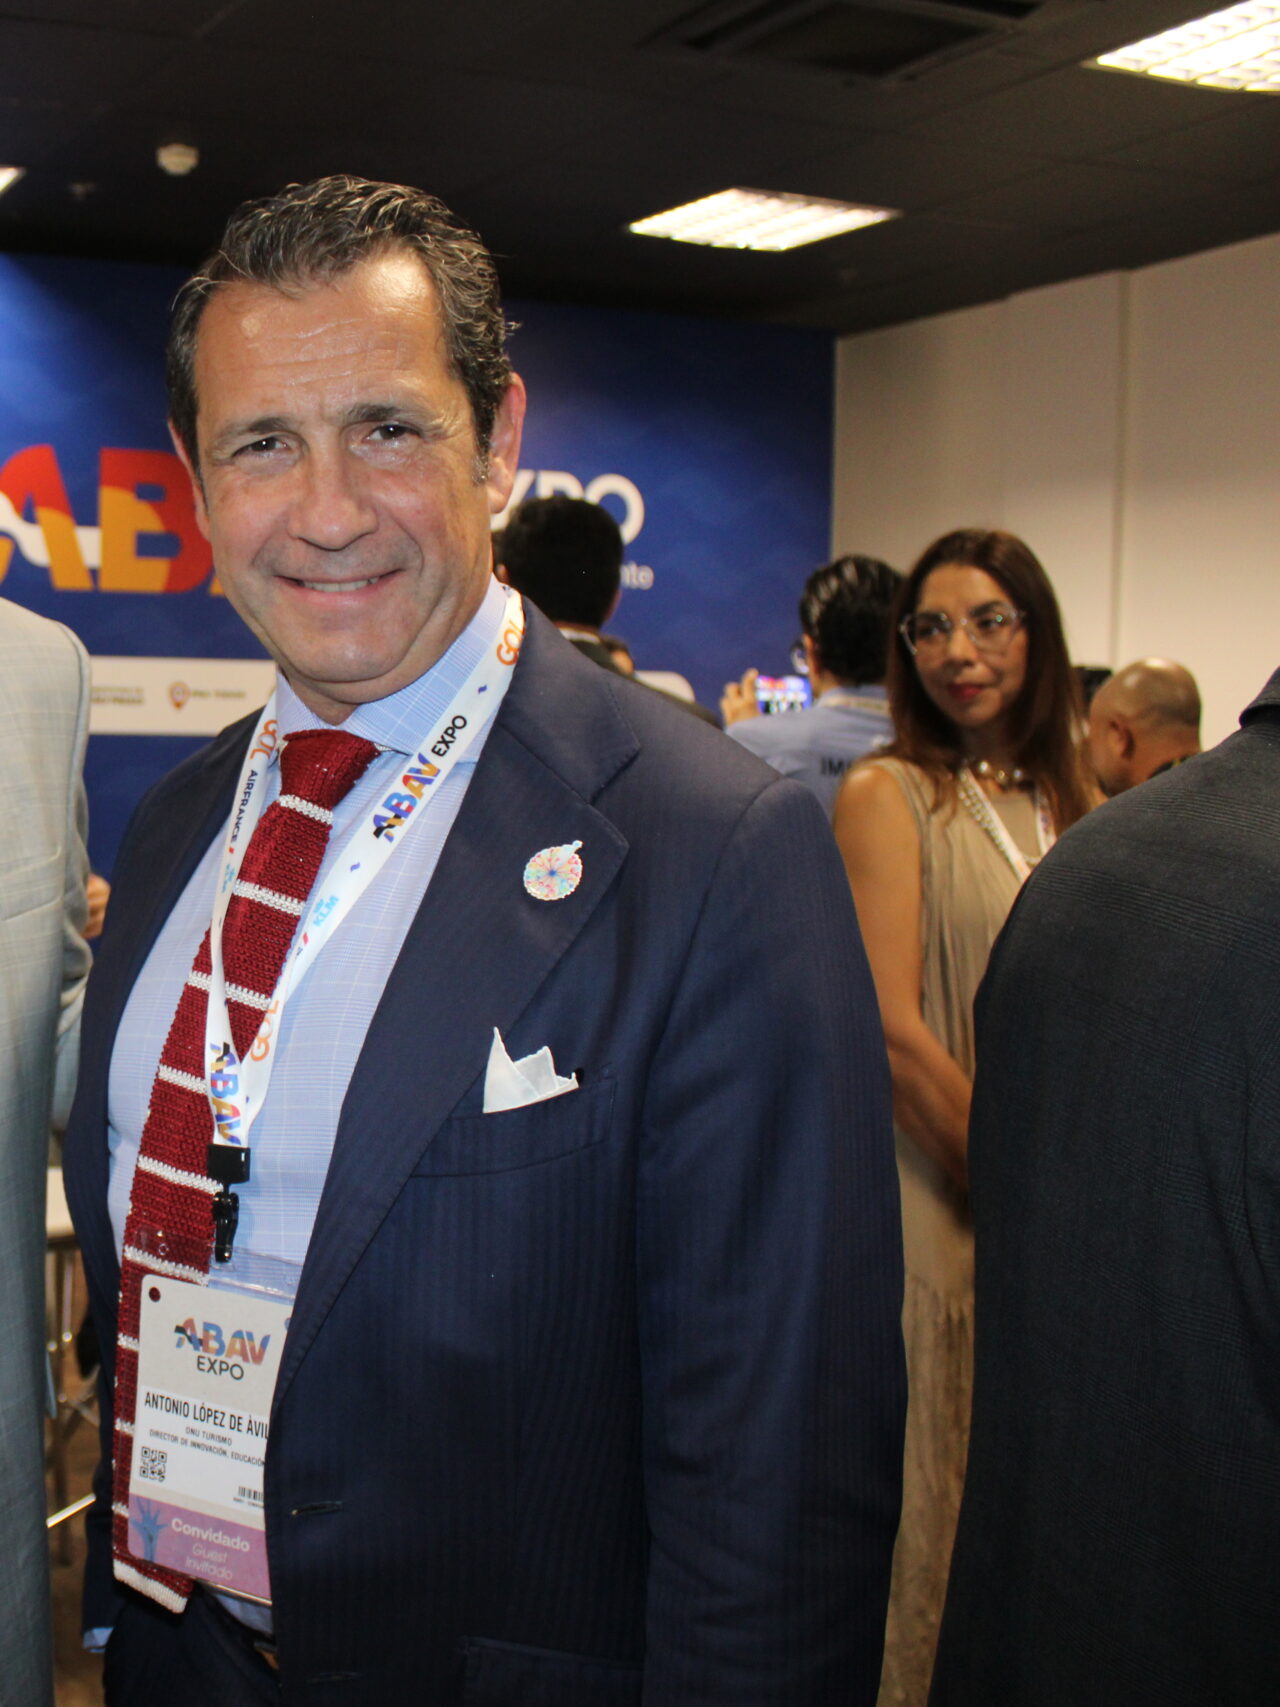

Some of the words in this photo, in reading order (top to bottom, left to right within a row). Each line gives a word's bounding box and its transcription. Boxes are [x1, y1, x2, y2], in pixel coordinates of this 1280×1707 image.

[373, 753, 441, 843] ABAV
[431, 715, 467, 757] EXPO
[231, 769, 258, 843] AIRFRANCE
[250, 1000, 279, 1062] GOL
[210, 1042, 241, 1146] ABAV
[174, 1317, 271, 1365] ABAV
[197, 1355, 244, 1380] EXPO
[145, 1391, 190, 1418] ANTONIO
[193, 1401, 225, 1428] LÓPEZ
[229, 1414, 244, 1432] DE
[246, 1414, 269, 1440] ÁVIL
[185, 1426, 201, 1435] ONU
[202, 1430, 232, 1446] TURISMO
[149, 1429, 178, 1444] DIRECTOR
[180, 1438, 188, 1446] DE
[171, 1517, 250, 1552] Convidado
[192, 1543, 228, 1562] Guest
[185, 1556, 233, 1579] Invitado
